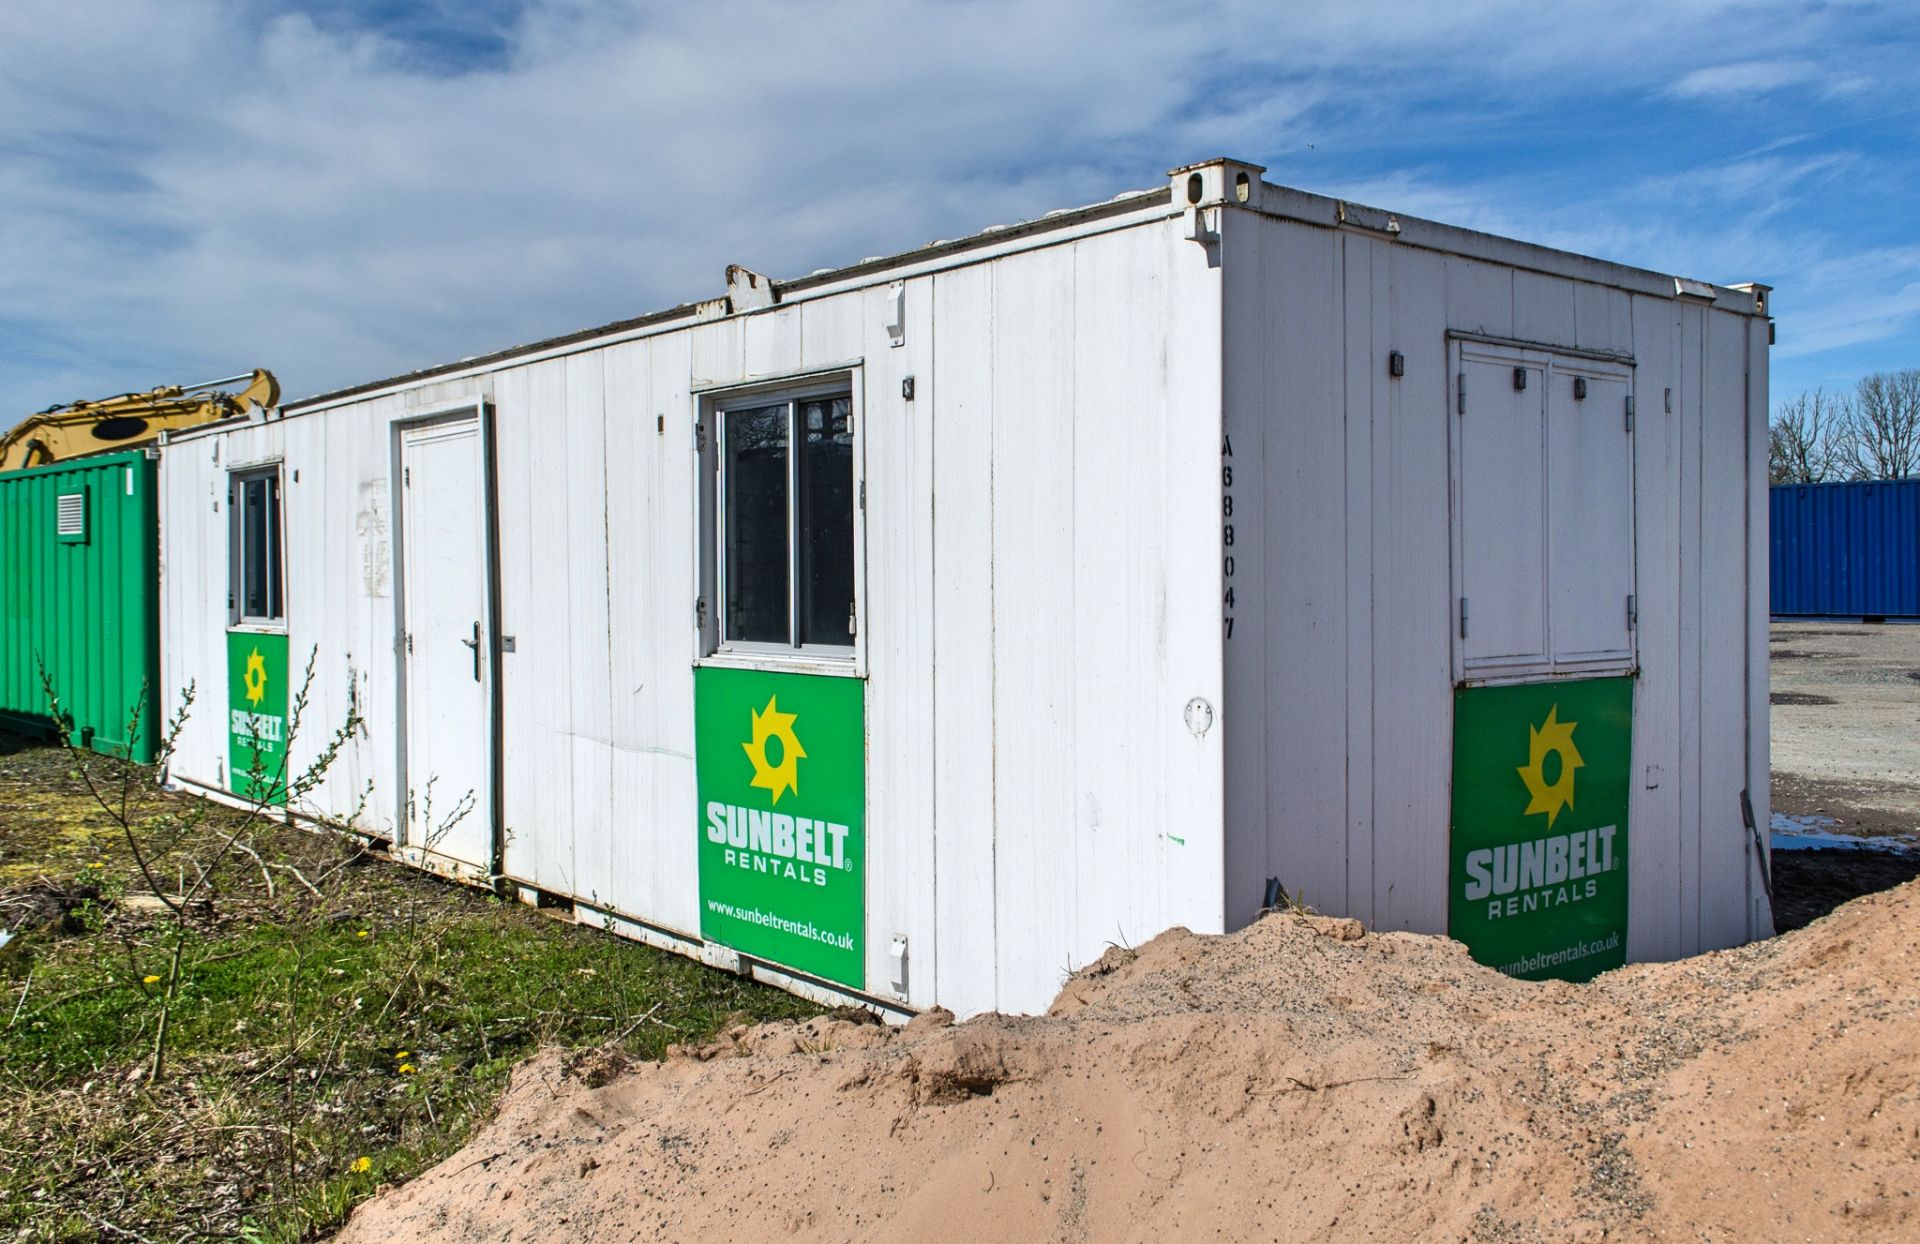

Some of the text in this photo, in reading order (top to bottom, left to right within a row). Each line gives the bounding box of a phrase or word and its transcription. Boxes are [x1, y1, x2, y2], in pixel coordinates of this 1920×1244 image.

[1221, 435, 1235, 639] A688047
[237, 736, 273, 752] REALS
[725, 849, 827, 886] RENTALS
[1488, 879, 1597, 920] RENTALS
[707, 898, 854, 951] www.sunbeltrentals.co.uk
